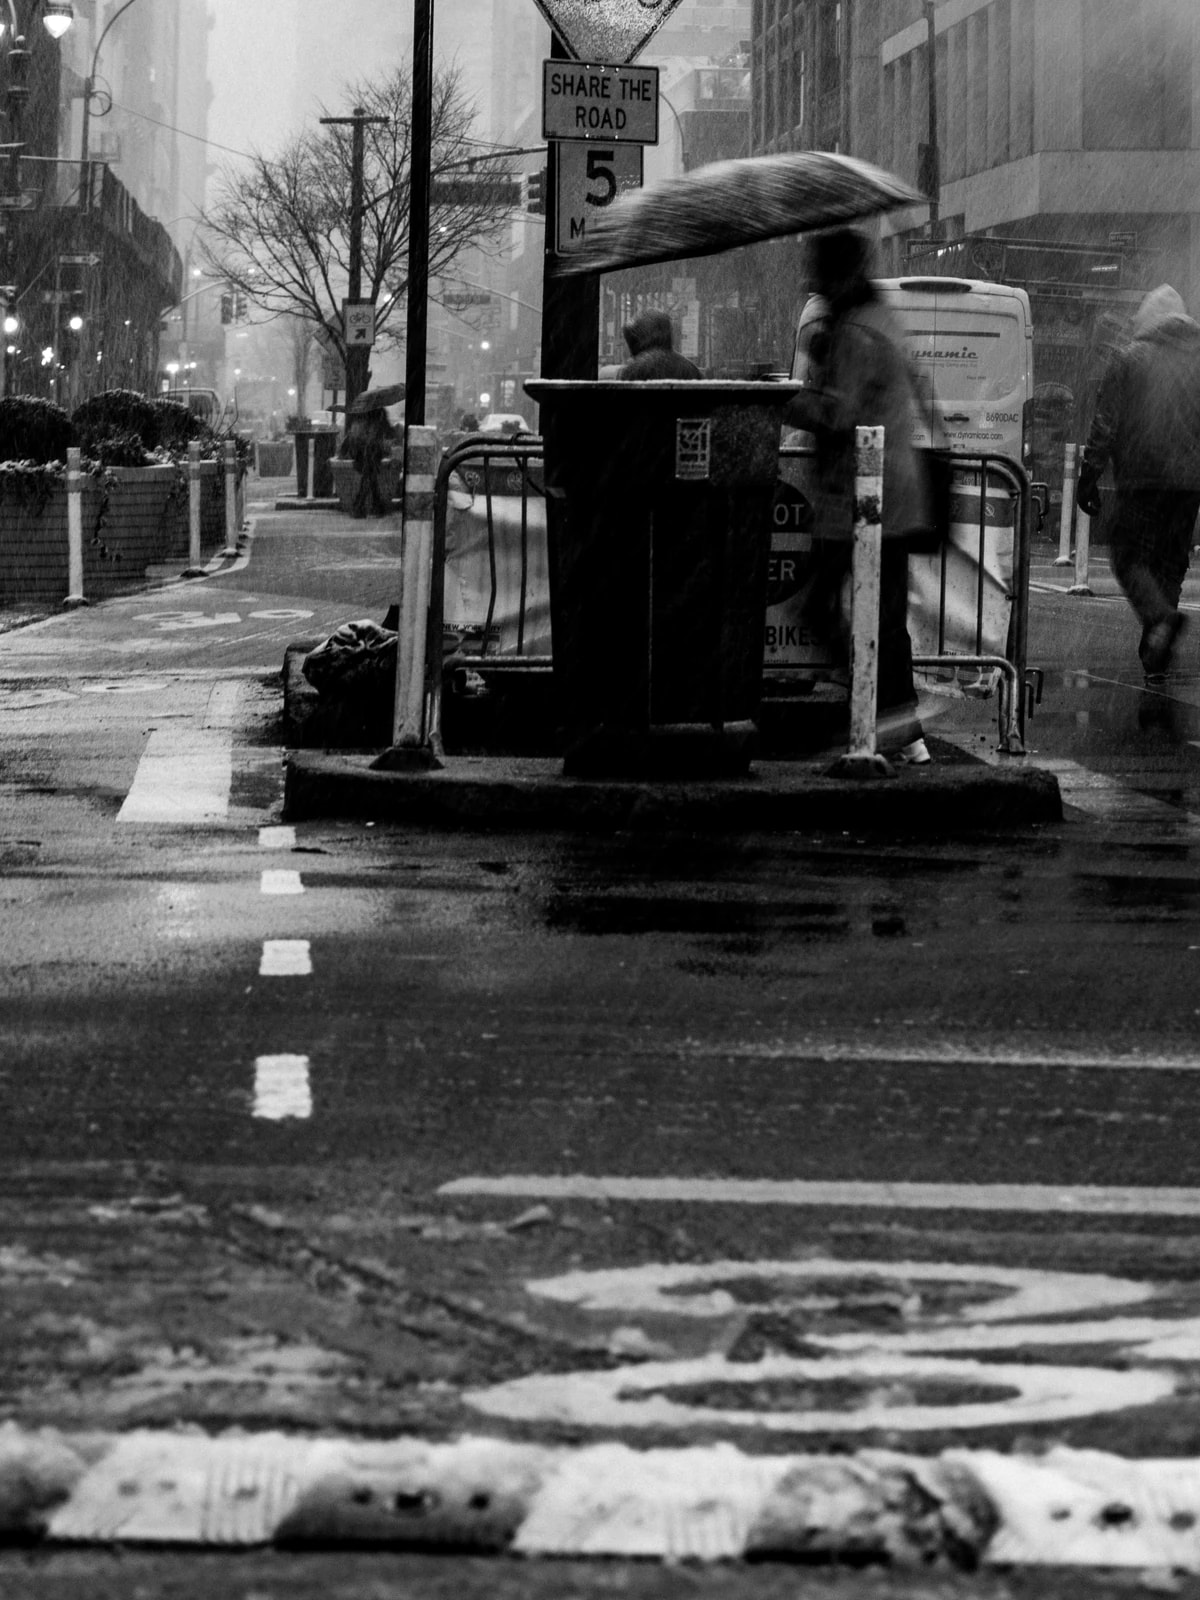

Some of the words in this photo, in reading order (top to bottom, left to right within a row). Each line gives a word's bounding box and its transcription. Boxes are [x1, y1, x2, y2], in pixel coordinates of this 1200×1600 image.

[550, 73, 611, 99] SHARE
[619, 78, 652, 102] THE
[575, 106, 627, 130] ROAD
[585, 150, 617, 207] 5
[985, 412, 1019, 423] 8690DAC
[772, 503, 805, 526] OT
